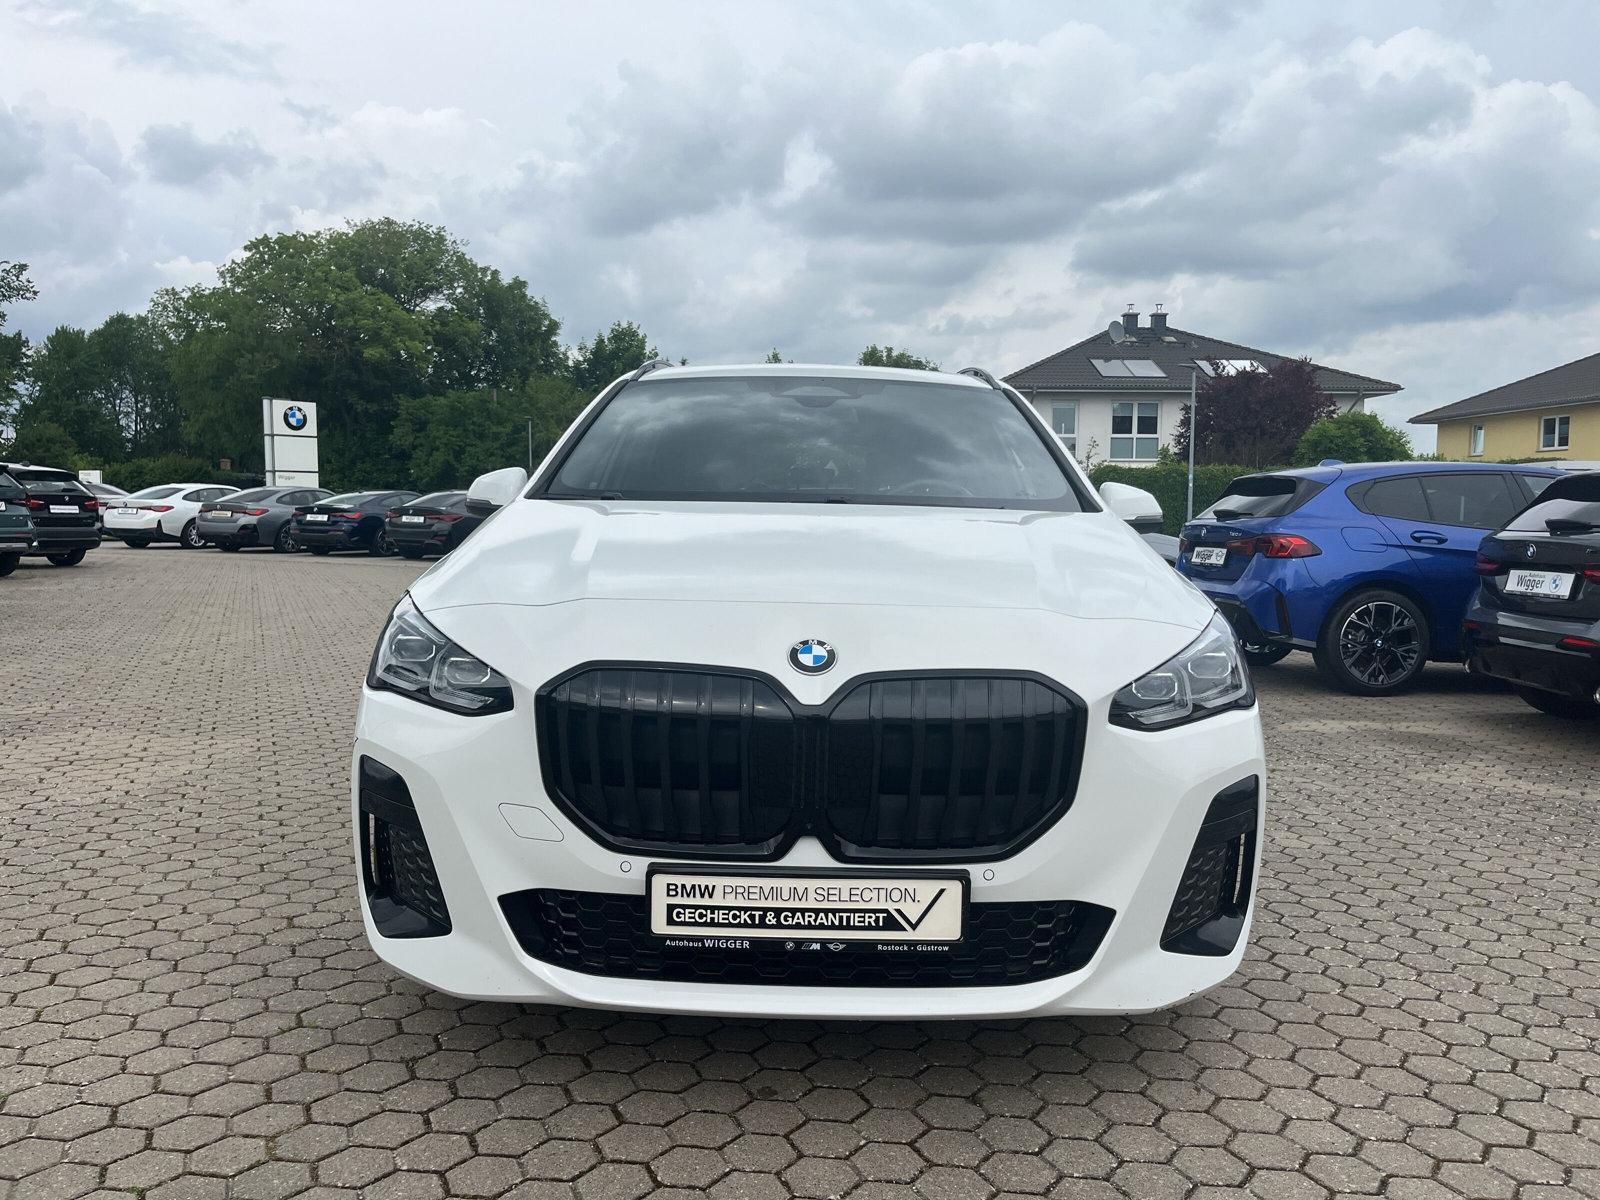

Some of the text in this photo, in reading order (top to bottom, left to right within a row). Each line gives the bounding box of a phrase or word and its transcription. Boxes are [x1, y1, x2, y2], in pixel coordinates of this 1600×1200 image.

[1195, 550, 1213, 561] Wigger
[1516, 574, 1546, 591] Wigger
[794, 639, 833, 650] BMW
[666, 883, 921, 903] BMW PREMIUM SELECTION.
[672, 908, 887, 927] GECHECKT & GARANTIERT
[665, 939, 750, 949] Autohaus WIGGER
